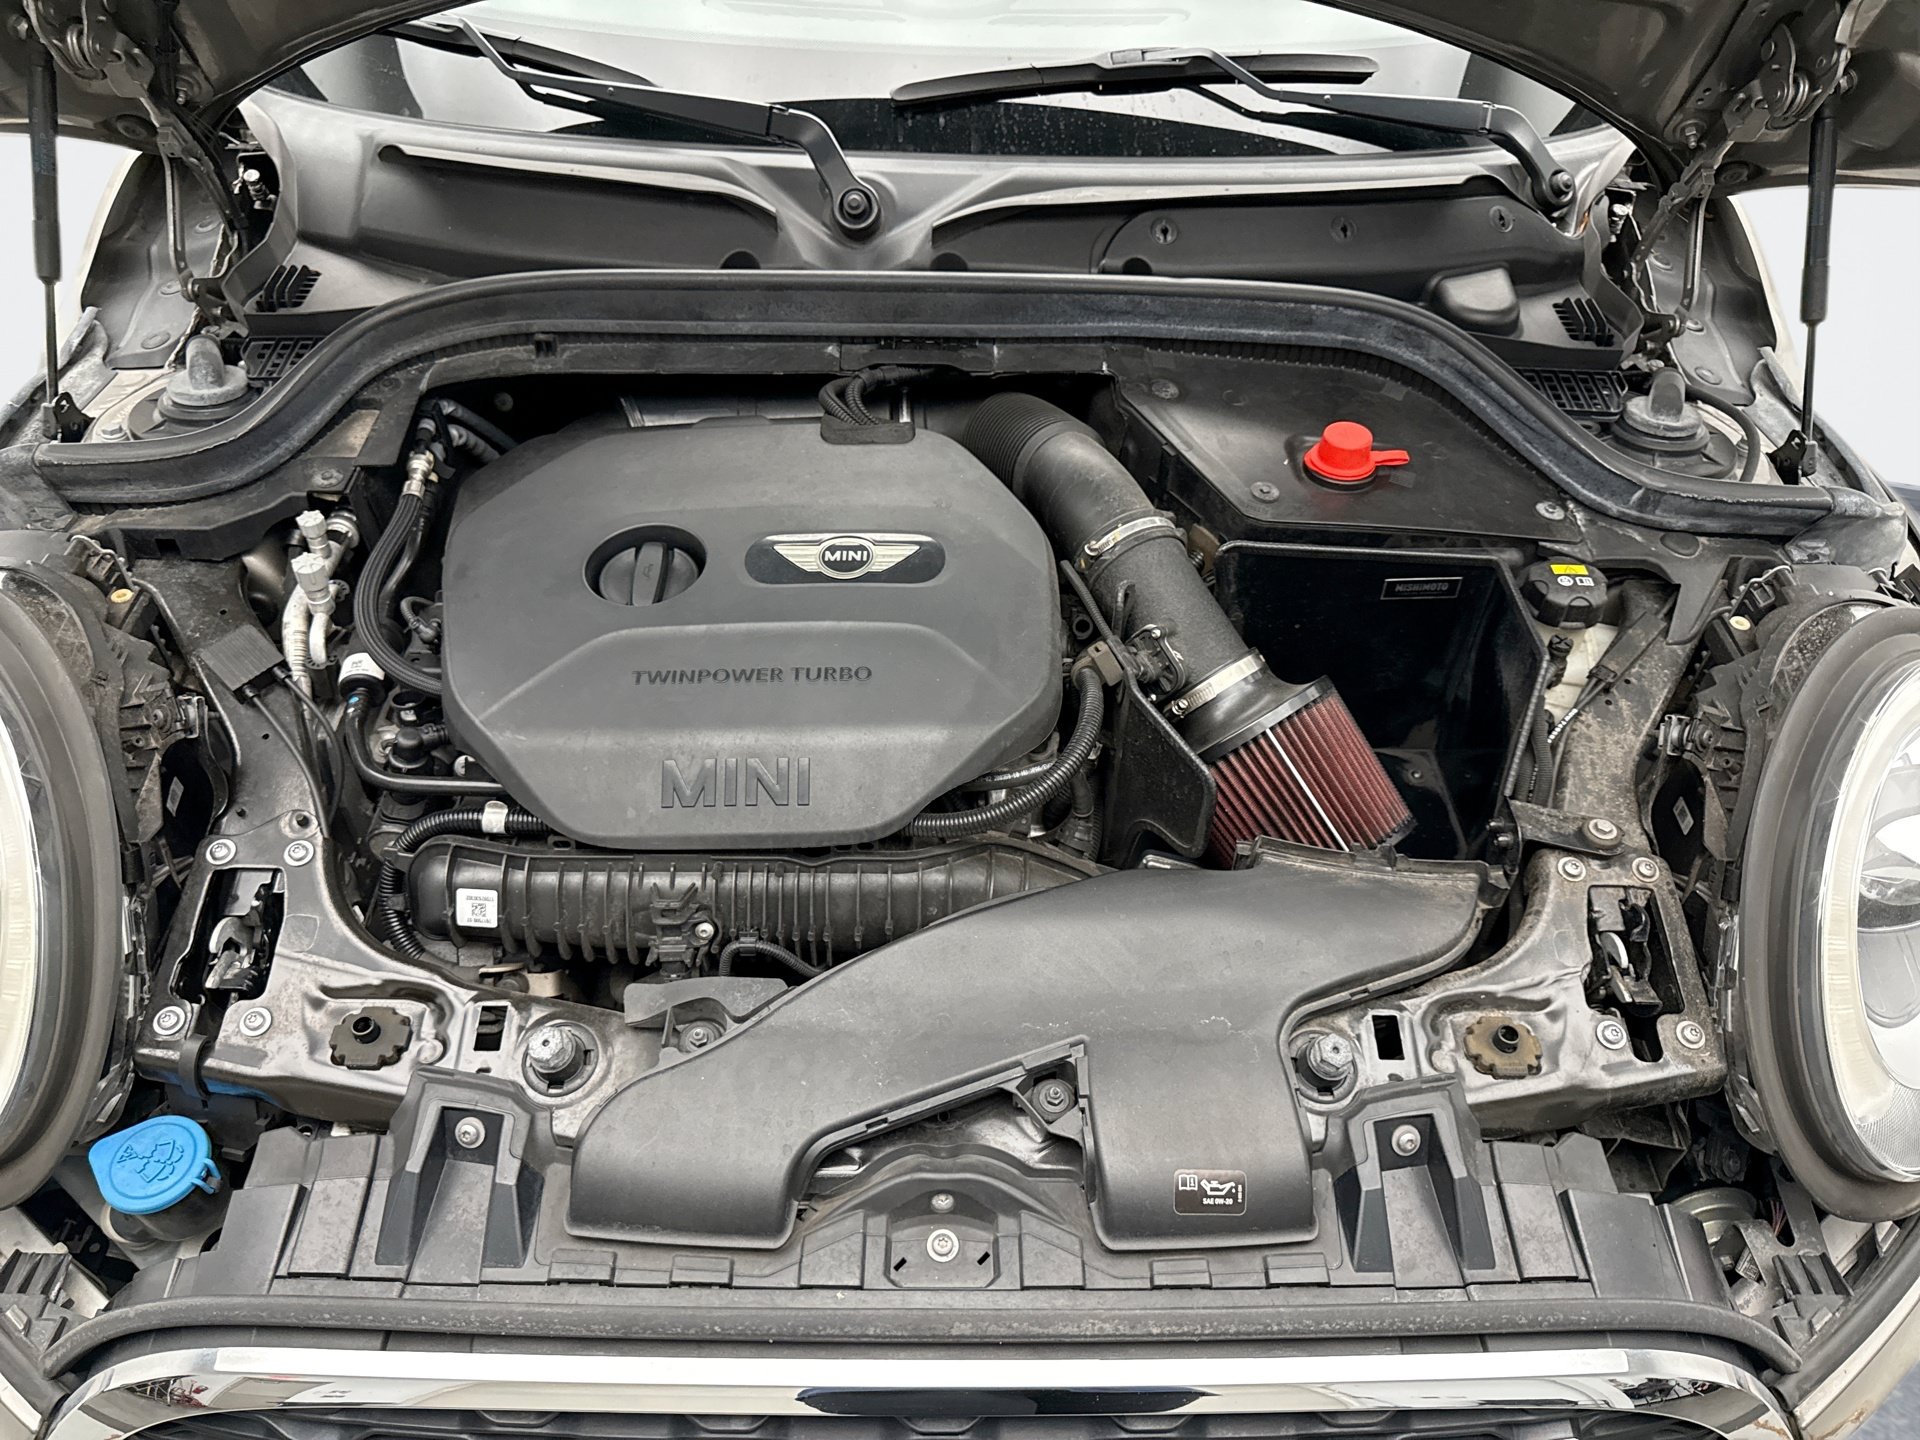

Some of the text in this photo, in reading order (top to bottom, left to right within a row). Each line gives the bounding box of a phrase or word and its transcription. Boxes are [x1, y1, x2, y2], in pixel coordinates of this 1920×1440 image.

[824, 550, 868, 562] MINI
[1395, 582, 1449, 592] MISHIMOTO
[632, 666, 873, 686] TWINPOWER TURBO
[661, 757, 811, 808] MINI
